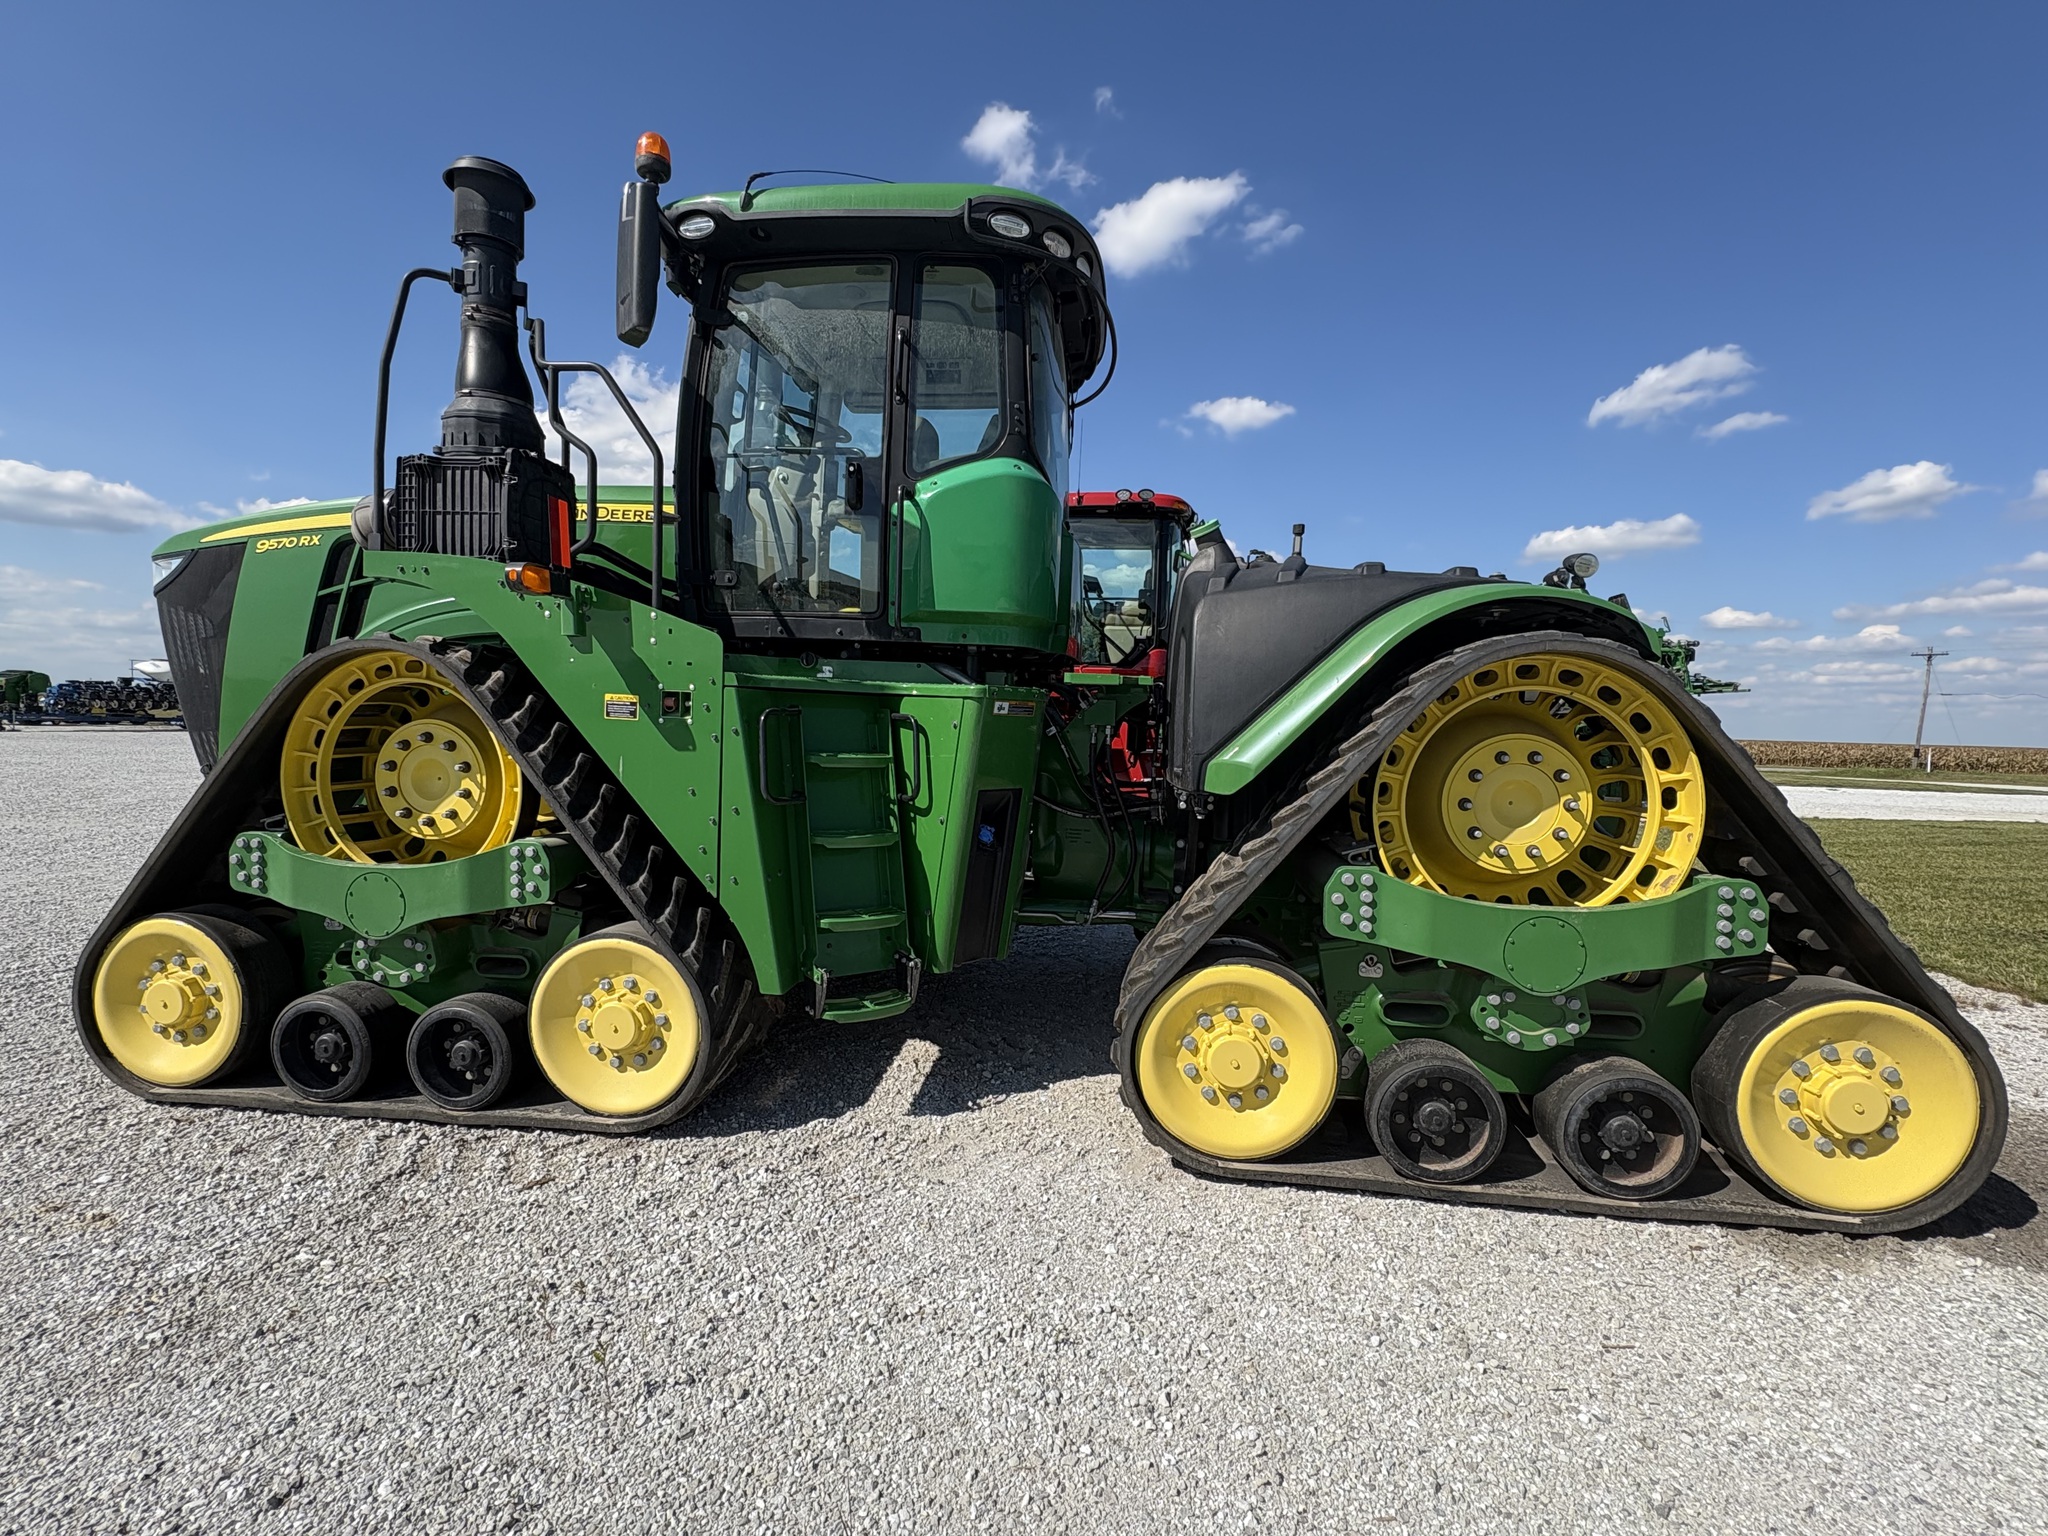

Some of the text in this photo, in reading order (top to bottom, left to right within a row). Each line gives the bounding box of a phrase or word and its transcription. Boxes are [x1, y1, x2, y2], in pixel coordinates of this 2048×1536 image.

[596, 507, 654, 521] DEERE
[255, 534, 322, 553] 9570 RX
